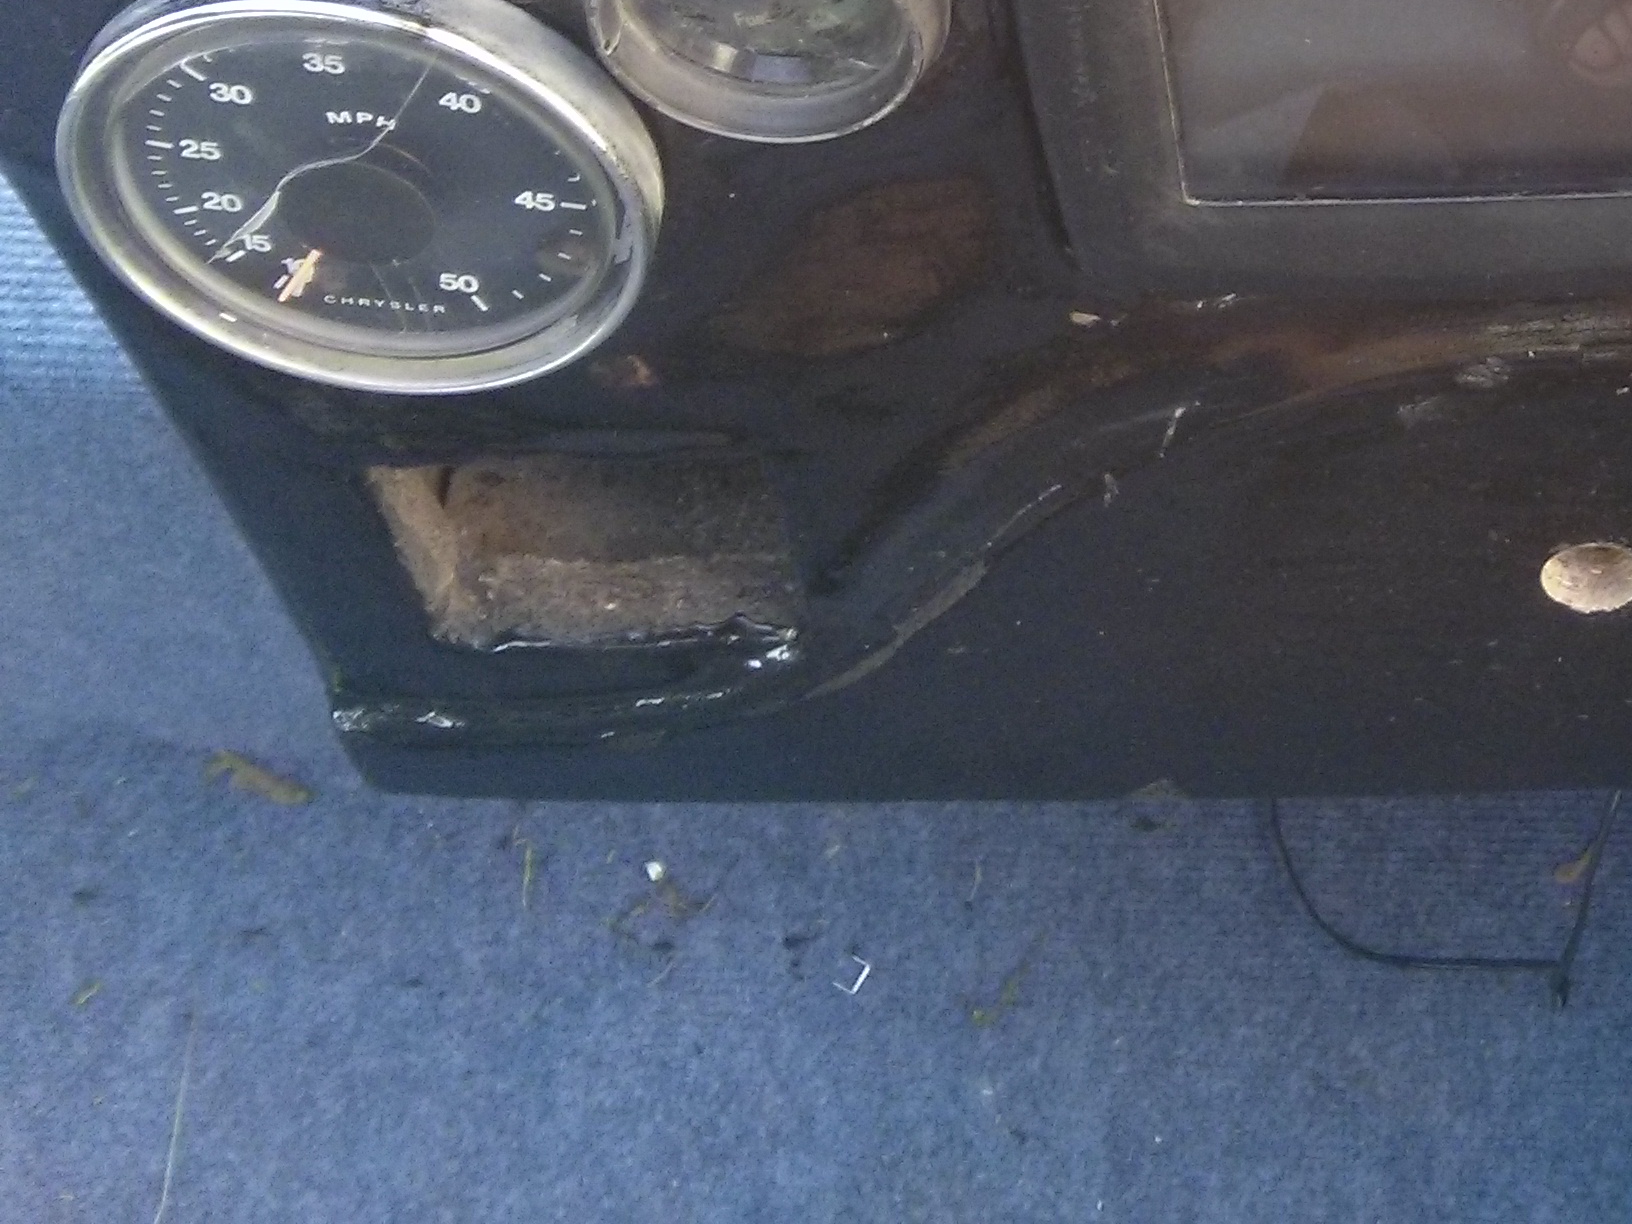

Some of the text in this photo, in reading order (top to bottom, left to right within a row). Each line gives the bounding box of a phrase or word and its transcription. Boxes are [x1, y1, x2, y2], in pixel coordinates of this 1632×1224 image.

[302, 52, 346, 75] 35
[209, 82, 253, 105] 30
[438, 91, 482, 114] 40
[325, 111, 396, 131] MPH
[178, 139, 221, 161] 25
[201, 191, 243, 213] 20
[514, 191, 556, 212] 45
[439, 273, 479, 294] 50
[323, 294, 446, 314] CHRYSLER
